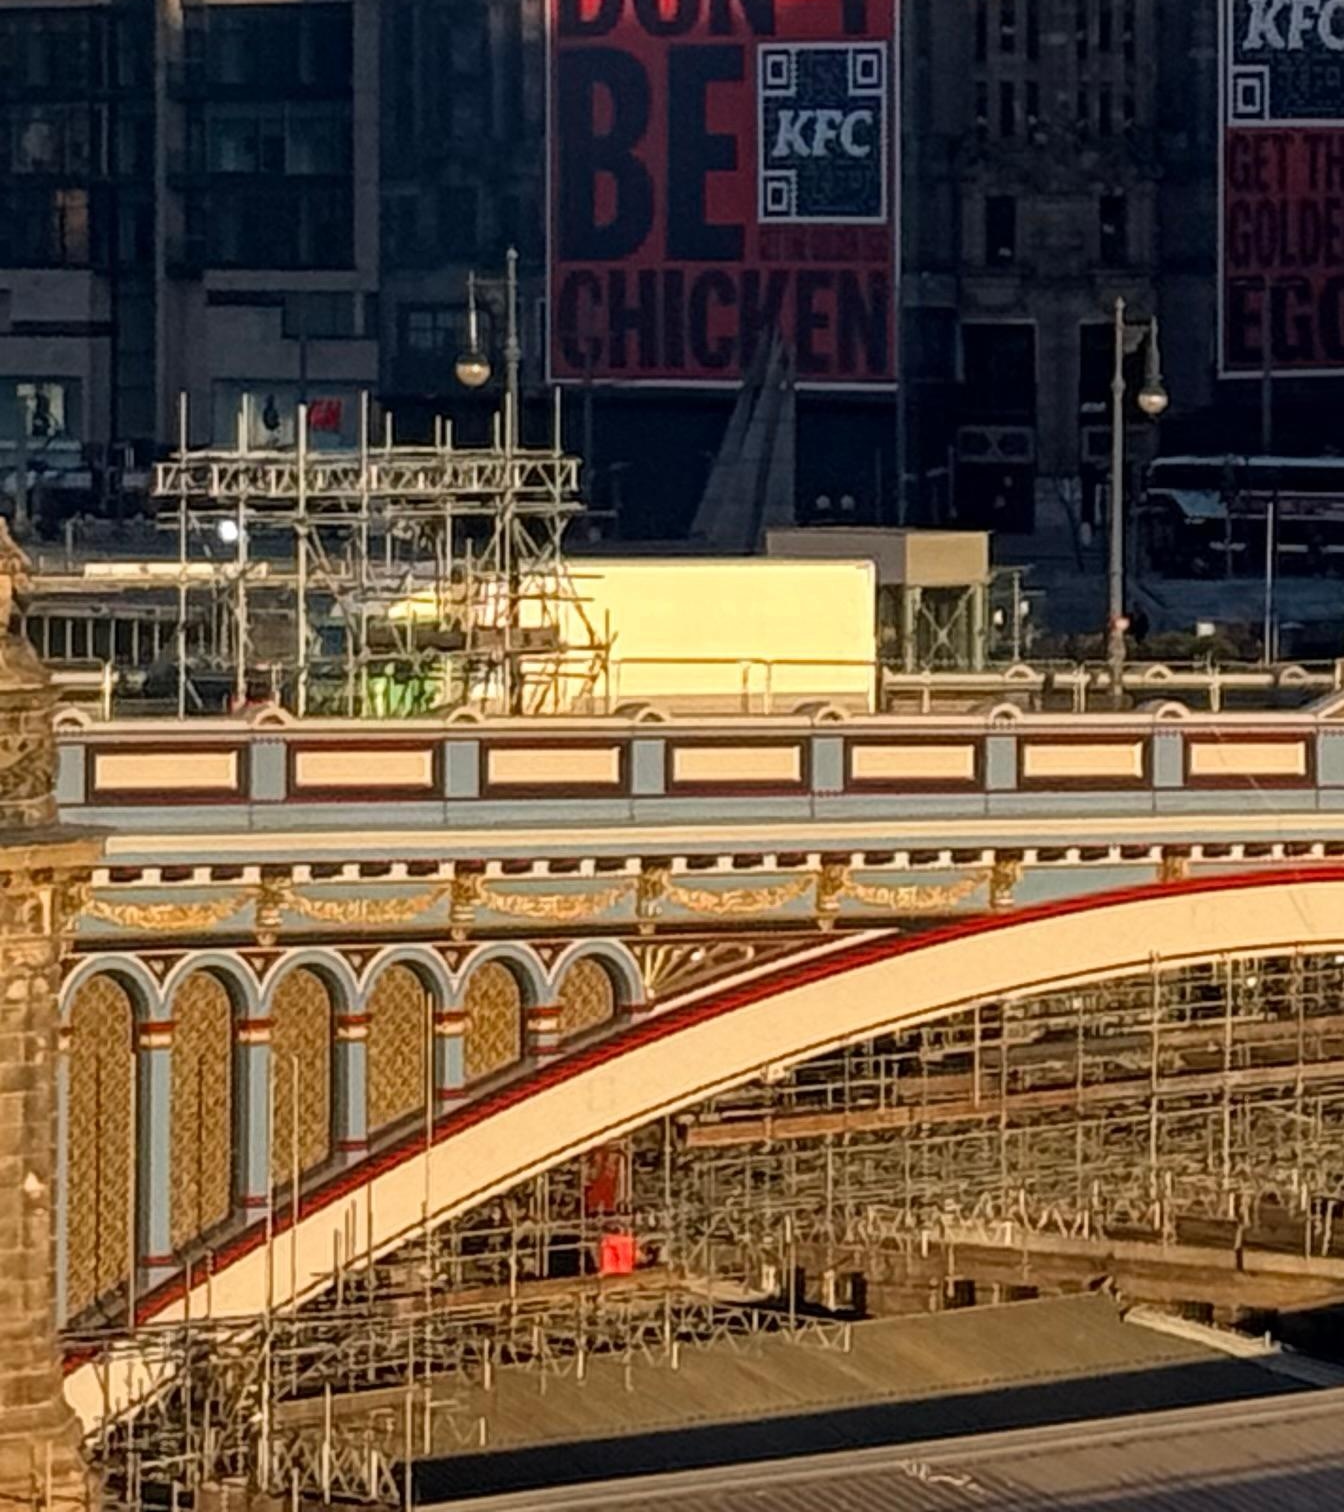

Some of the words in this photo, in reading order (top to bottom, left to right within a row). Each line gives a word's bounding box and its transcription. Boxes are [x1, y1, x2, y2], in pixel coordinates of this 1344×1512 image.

[557, 44, 745, 263] BE
[771, 109, 874, 158] KFC
[1229, 133, 1290, 192] GET
[557, 268, 890, 372] CHICKEN
